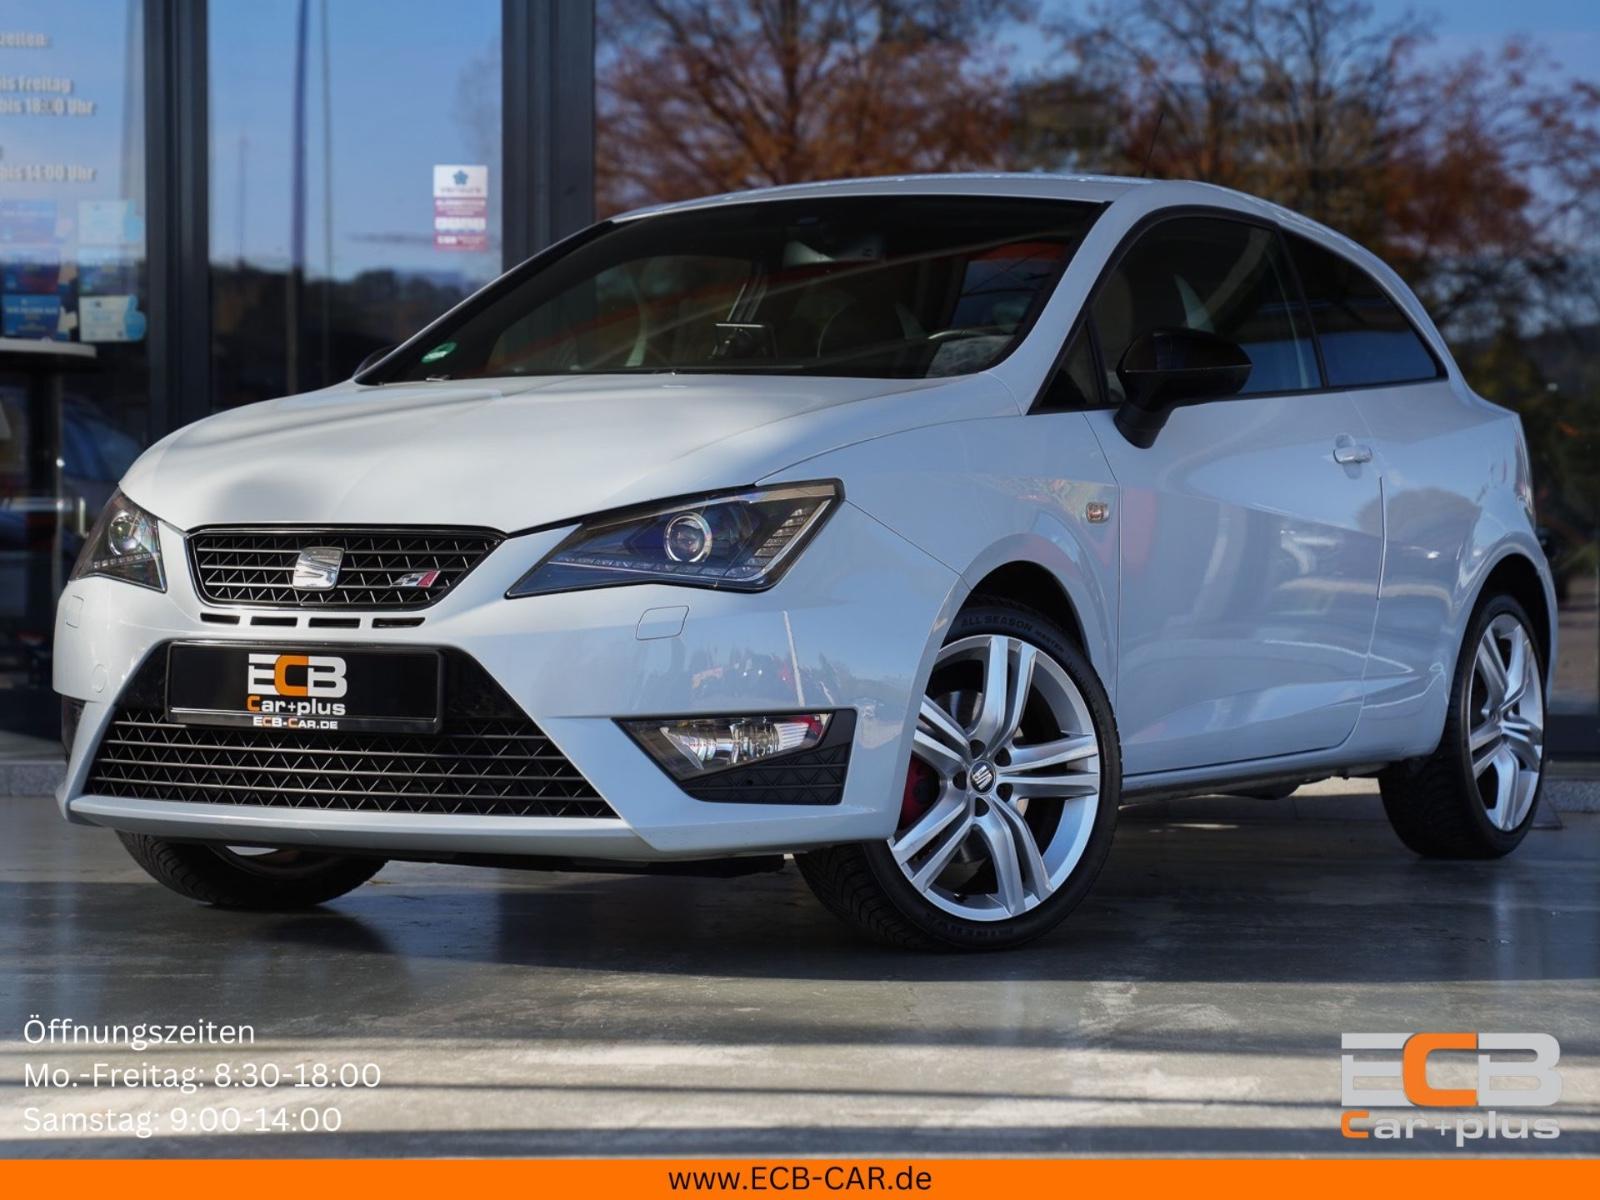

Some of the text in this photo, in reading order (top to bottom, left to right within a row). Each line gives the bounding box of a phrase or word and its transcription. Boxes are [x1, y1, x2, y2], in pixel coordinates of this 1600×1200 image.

[67, 98, 95, 114] Uhr
[67, 164, 95, 181] Uhr
[961, 615, 1033, 632] ALL SEASON
[247, 653, 348, 698] ECB
